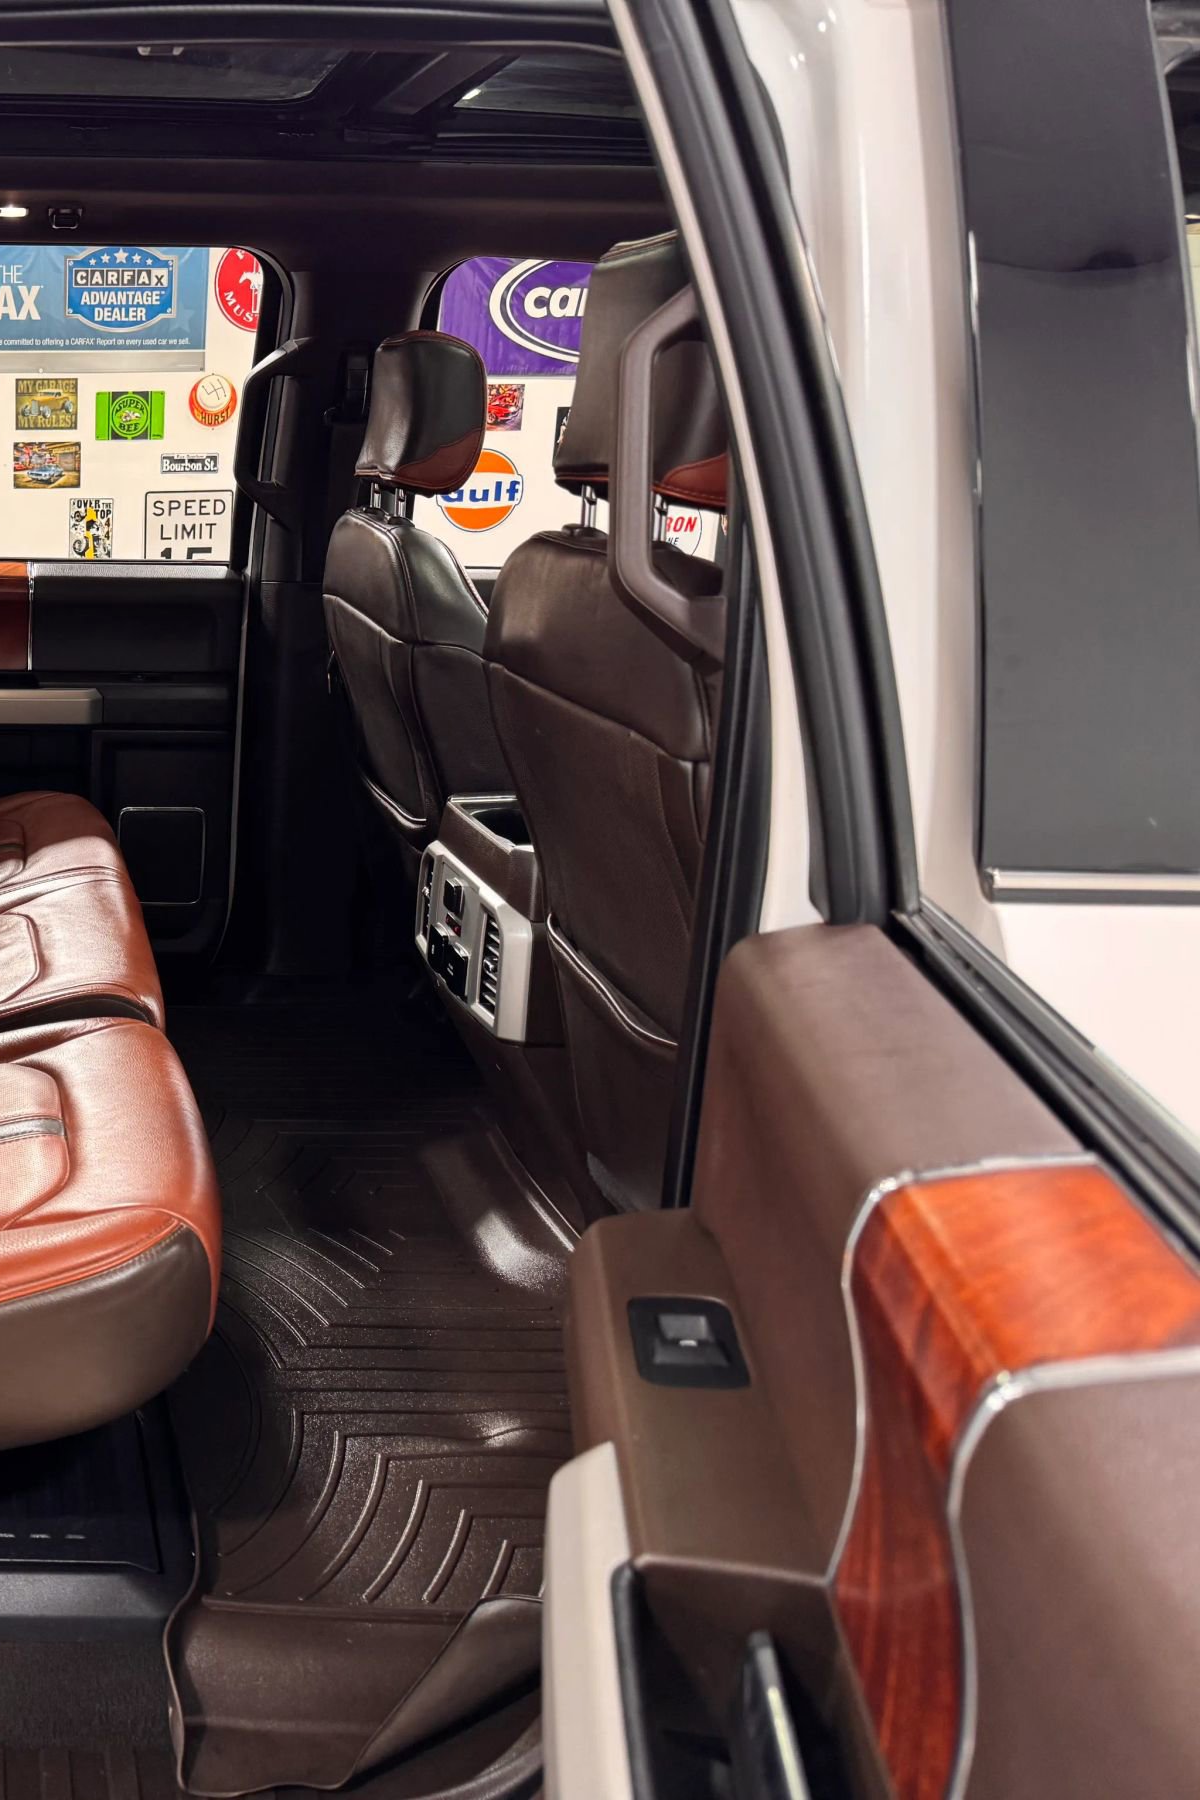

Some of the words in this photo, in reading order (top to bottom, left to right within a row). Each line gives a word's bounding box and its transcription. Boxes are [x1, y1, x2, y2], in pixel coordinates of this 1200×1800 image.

[76, 271, 165, 287] CARFAX
[80, 291, 161, 305] ADVANTAGE
[94, 307, 147, 321] DEALER
[3, 337, 34, 346] committed
[34, 337, 41, 346] to
[41, 337, 64, 348] offering
[96, 337, 116, 348] Report
[125, 339, 142, 348] every
[142, 337, 157, 346] used
[178, 337, 191, 346] sell.
[18, 379, 33, 393] MY
[36, 379, 76, 393] GARAGE
[115, 399, 145, 415] SUPER
[17, 415, 35, 428] MY
[37, 415, 76, 428] RULES!
[200, 406, 230, 426] HURST
[118, 422, 140, 433] BEE
[162, 458, 202, 471] Bourbon
[203, 458, 218, 471] St.
[76, 499, 100, 509] OVER
[152, 498, 226, 517] SPEED
[94, 509, 112, 519] TOP
[160, 522, 217, 540] LIMIT
